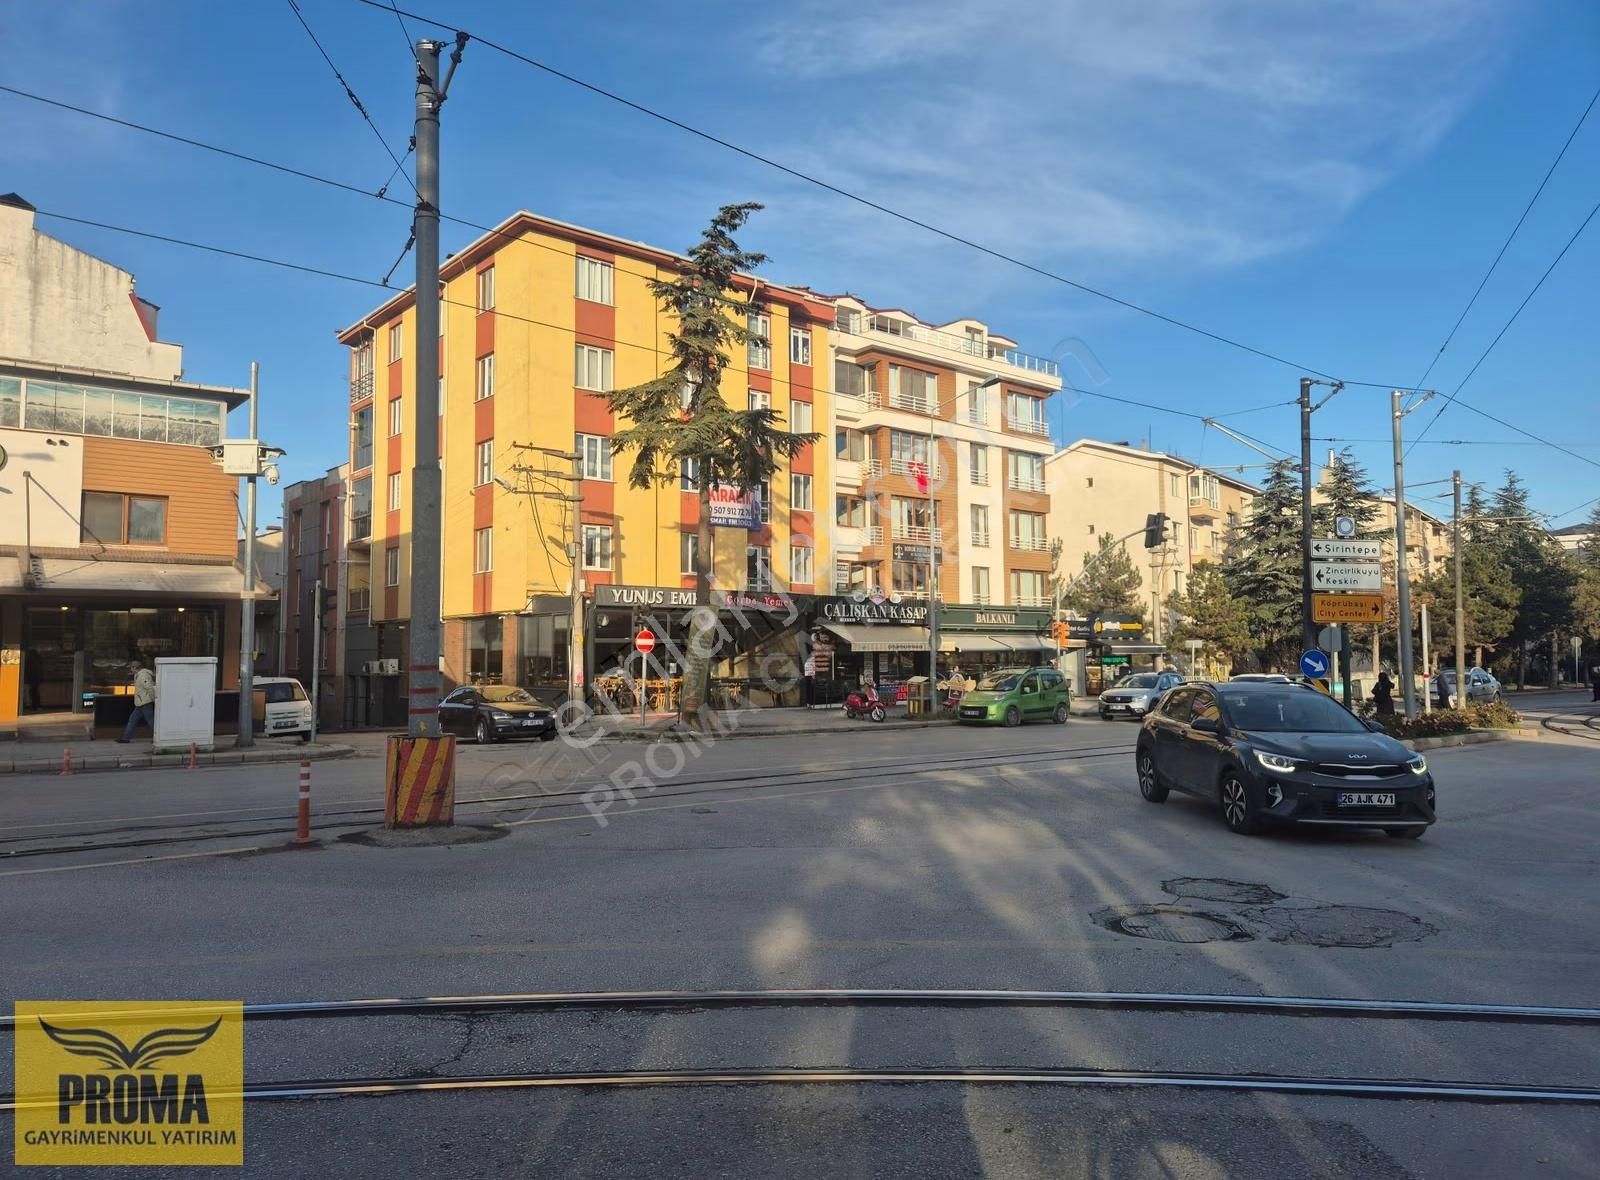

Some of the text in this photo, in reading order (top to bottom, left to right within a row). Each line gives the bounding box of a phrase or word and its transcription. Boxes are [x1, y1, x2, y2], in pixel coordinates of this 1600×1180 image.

[1325, 566, 1379, 576] Zincirlikuyu
[612, 588, 664, 604] YUNUS
[824, 603, 928, 620] ÇALIŞKAN KASAP
[976, 613, 1016, 624] BALKANLI
[1343, 794, 1394, 804] 26 AJK 471
